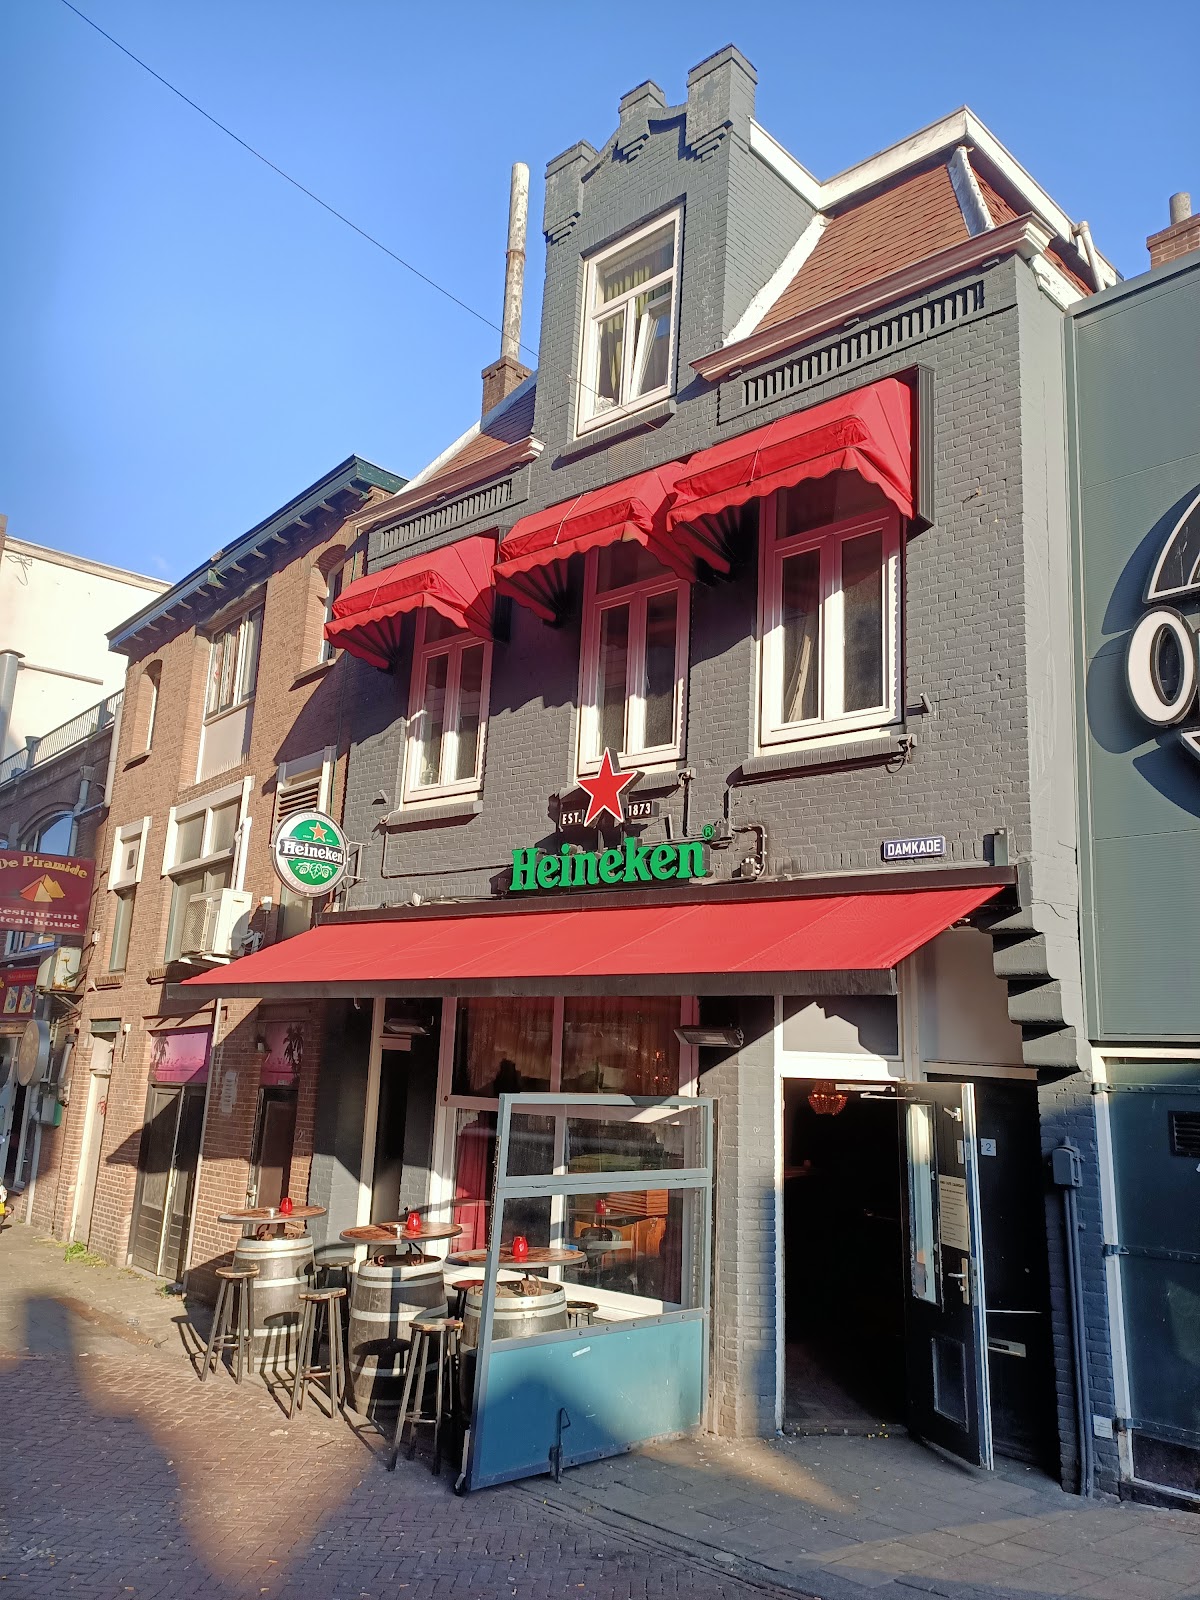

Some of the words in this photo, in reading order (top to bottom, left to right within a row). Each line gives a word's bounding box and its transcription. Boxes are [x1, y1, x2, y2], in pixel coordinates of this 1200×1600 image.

[1127, 609, 1200, 726] O
[562, 811, 582, 825] EST.
[627, 802, 651, 817] 1873
[283, 841, 343, 863] Heineken
[887, 840, 941, 856] DAMKADE
[22, 855, 88, 879] Piramide
[509, 836, 708, 890] Heineken
[0, 916, 80, 929] teakhouse
[985, 1142, 992, 1152] 2
